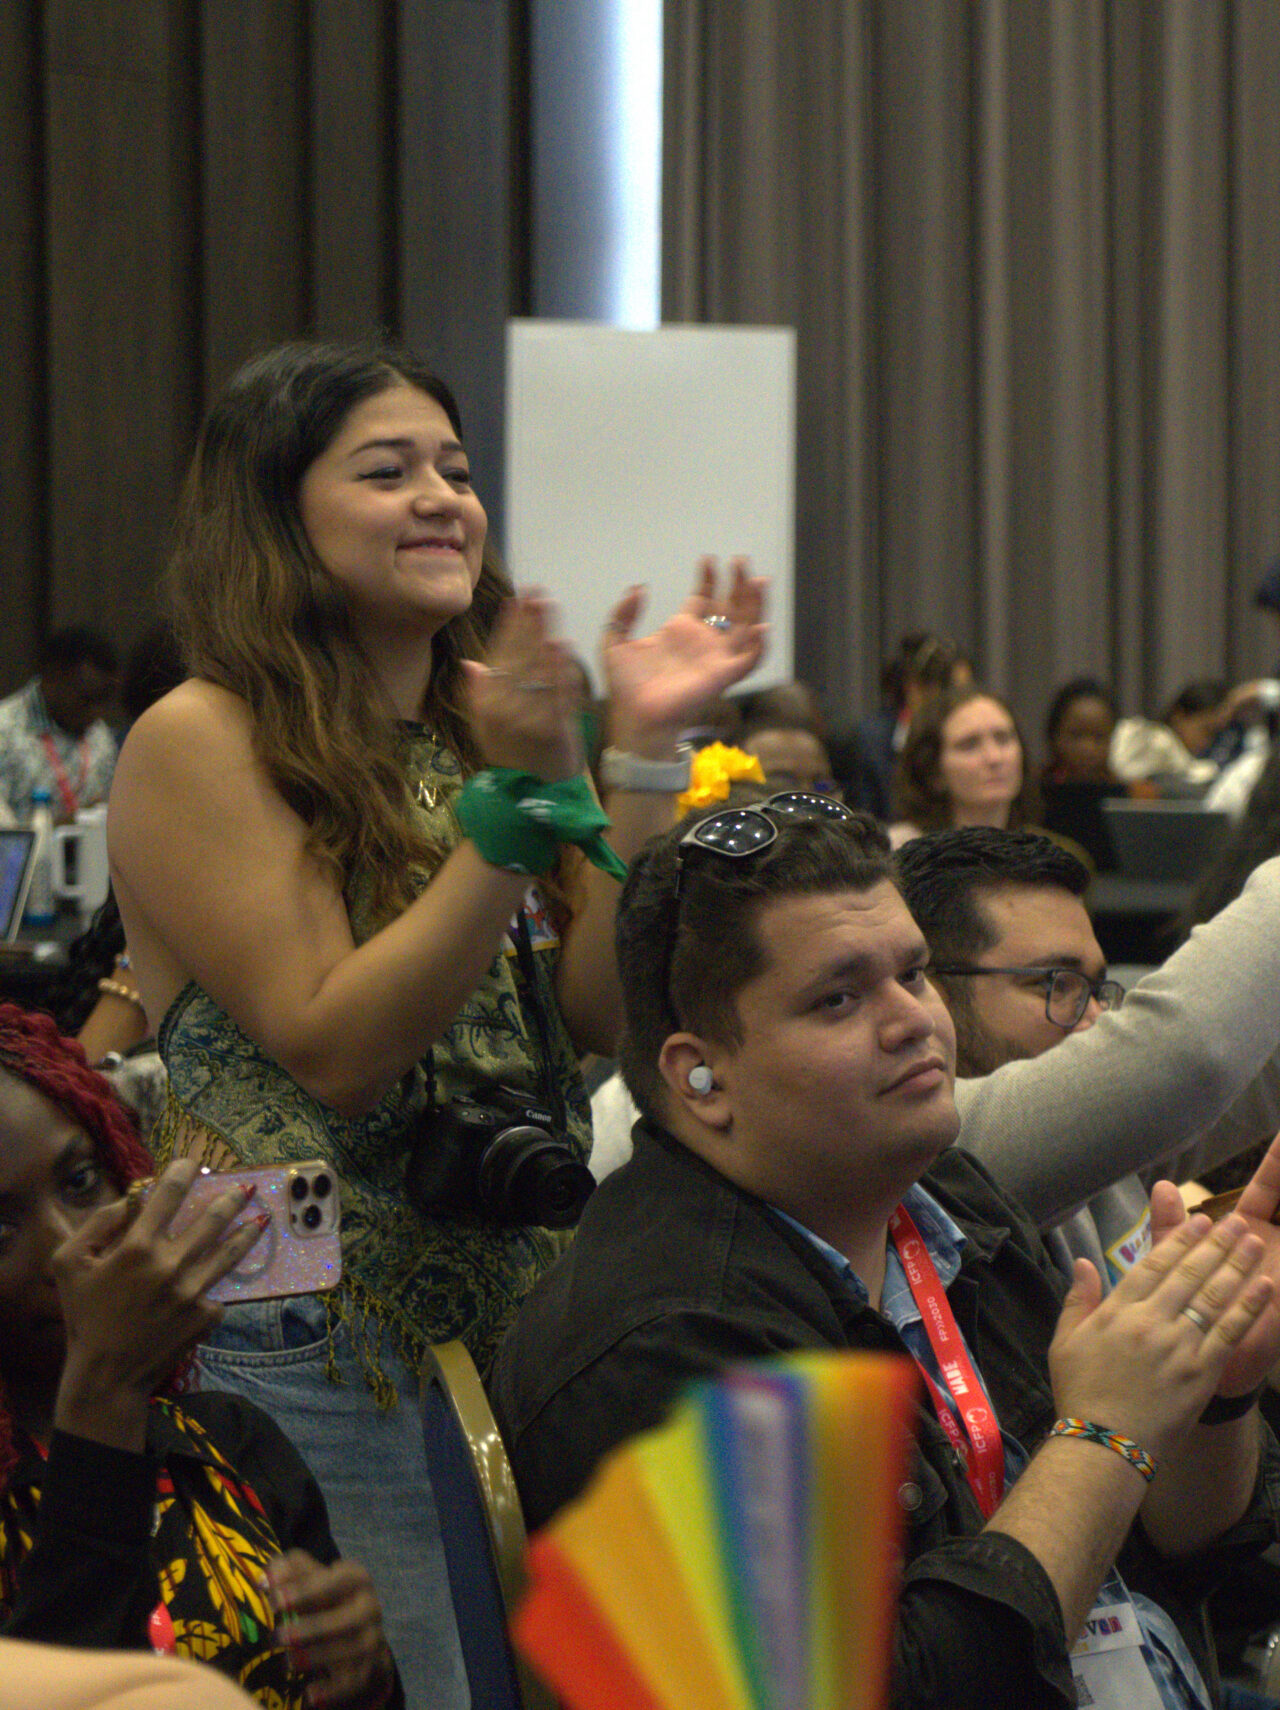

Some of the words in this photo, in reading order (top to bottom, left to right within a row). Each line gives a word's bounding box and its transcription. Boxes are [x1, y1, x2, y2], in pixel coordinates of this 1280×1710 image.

[525, 1109, 552, 1122] Canon
[907, 1261, 923, 1286] ICFP
[939, 1408, 960, 1437] ICFP
[970, 1424, 988, 1455] ICFP
